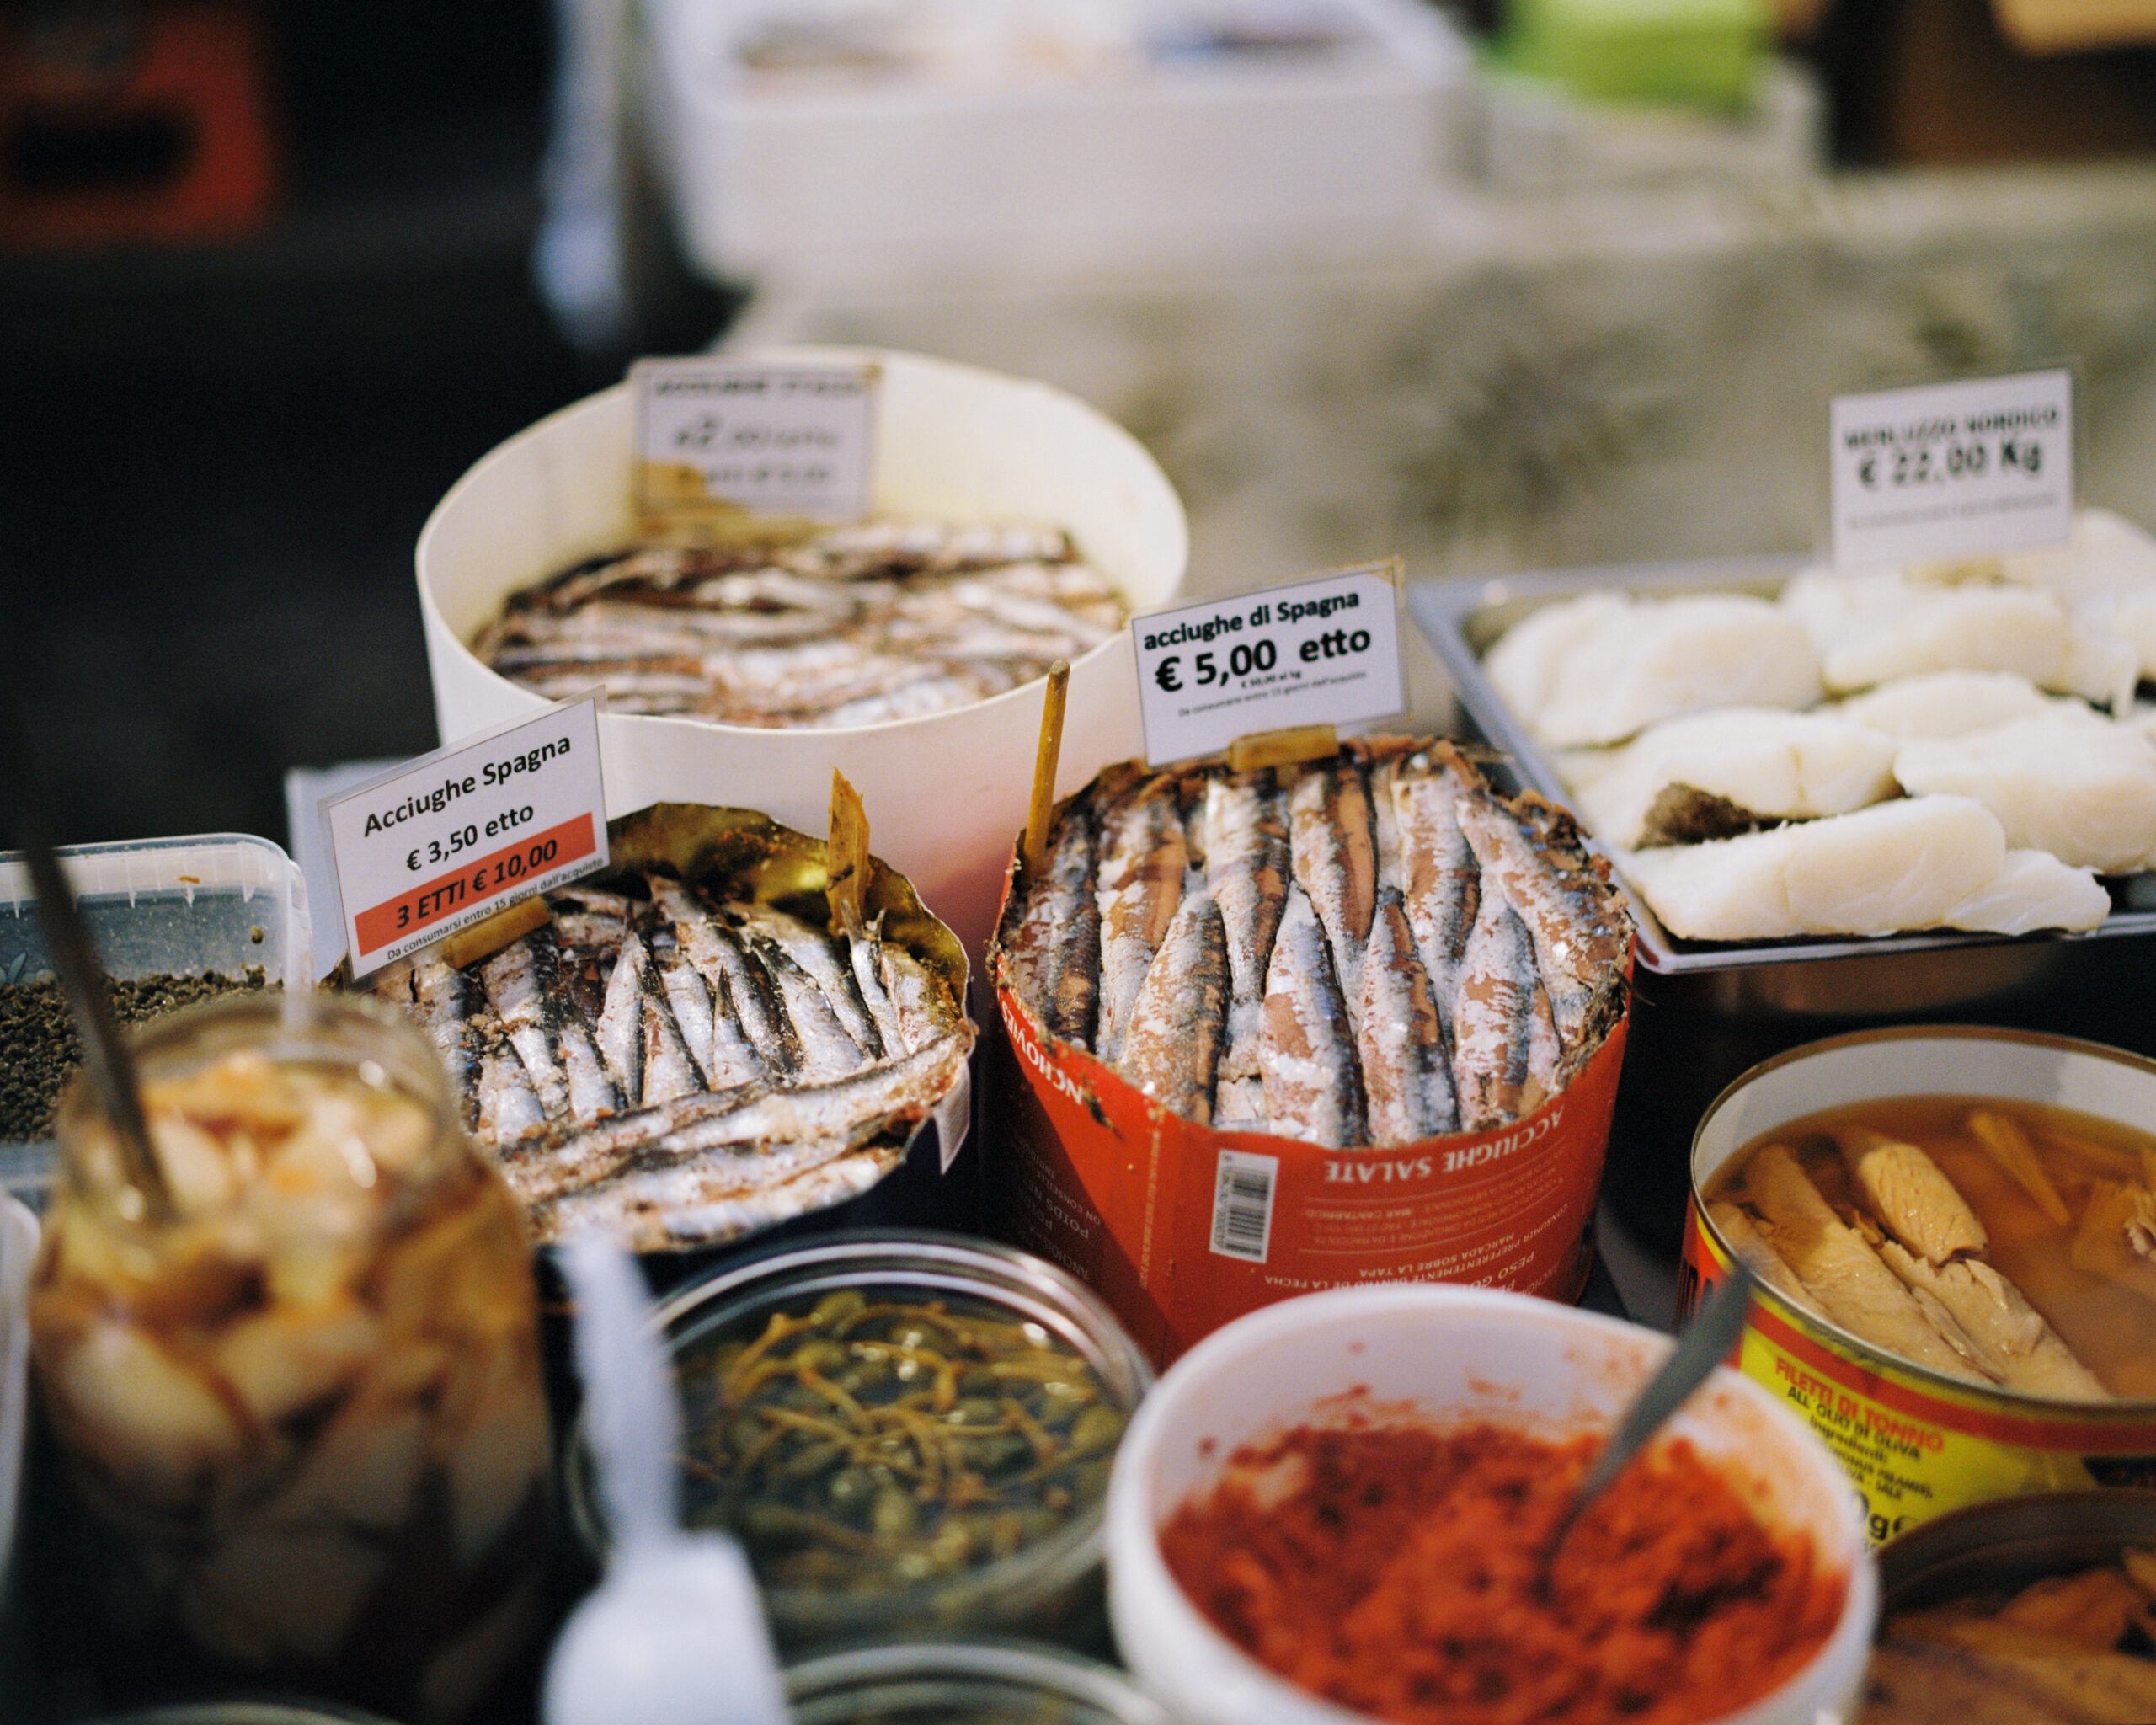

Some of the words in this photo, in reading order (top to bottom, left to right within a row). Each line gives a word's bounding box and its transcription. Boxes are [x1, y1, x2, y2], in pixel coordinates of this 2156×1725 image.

[1144, 615, 1243, 651] acciughe
[1249, 605, 1270, 628] di
[1277, 591, 1359, 624] Spagna
[1155, 656, 1183, 692] €
[1196, 638, 1277, 686] 5,00
[1299, 628, 1371, 663] etto
[364, 773, 477, 838] Acciughe
[483, 735, 572, 787] Spagna
[406, 848, 423, 872] €
[428, 824, 478, 865] 3,50
[485, 804, 534, 838] etto
[387, 945, 403, 961] Da
[403, 918, 462, 954] consumarsi
[463, 904, 492, 926] entro
[494, 897, 507, 912] 15
[509, 884, 538, 906] giorni
[539, 857, 604, 892] dall'acquisto
[396, 905, 410, 930] 3
[417, 880, 466, 920] ETTI
[472, 868, 487, 893] €
[494, 838, 558, 884] 10,00
[1002, 1000, 1083, 1105] NCHOVIES
[1442, 1105, 1565, 1172] ACCIUGHE
[1325, 1156, 1433, 1184] SALATE
[1046, 1198, 1090, 1240] POIDS
[1397, 1264, 1413, 1275] LA
[1417, 1252, 1459, 1272] SOBRE
[1460, 1231, 1515, 1260] MARCADA
[1498, 1249, 1535, 1279] PESO
[1265, 1274, 1308, 1289] FECHA
[1359, 1267, 1393, 1279] TAPA
[1775, 1356, 1833, 1405] FILETTI
[1838, 1394, 1860, 1418] DI
[1864, 1406, 1945, 1454] TONNO
[1816, 1402, 1851, 1427] OLIO
